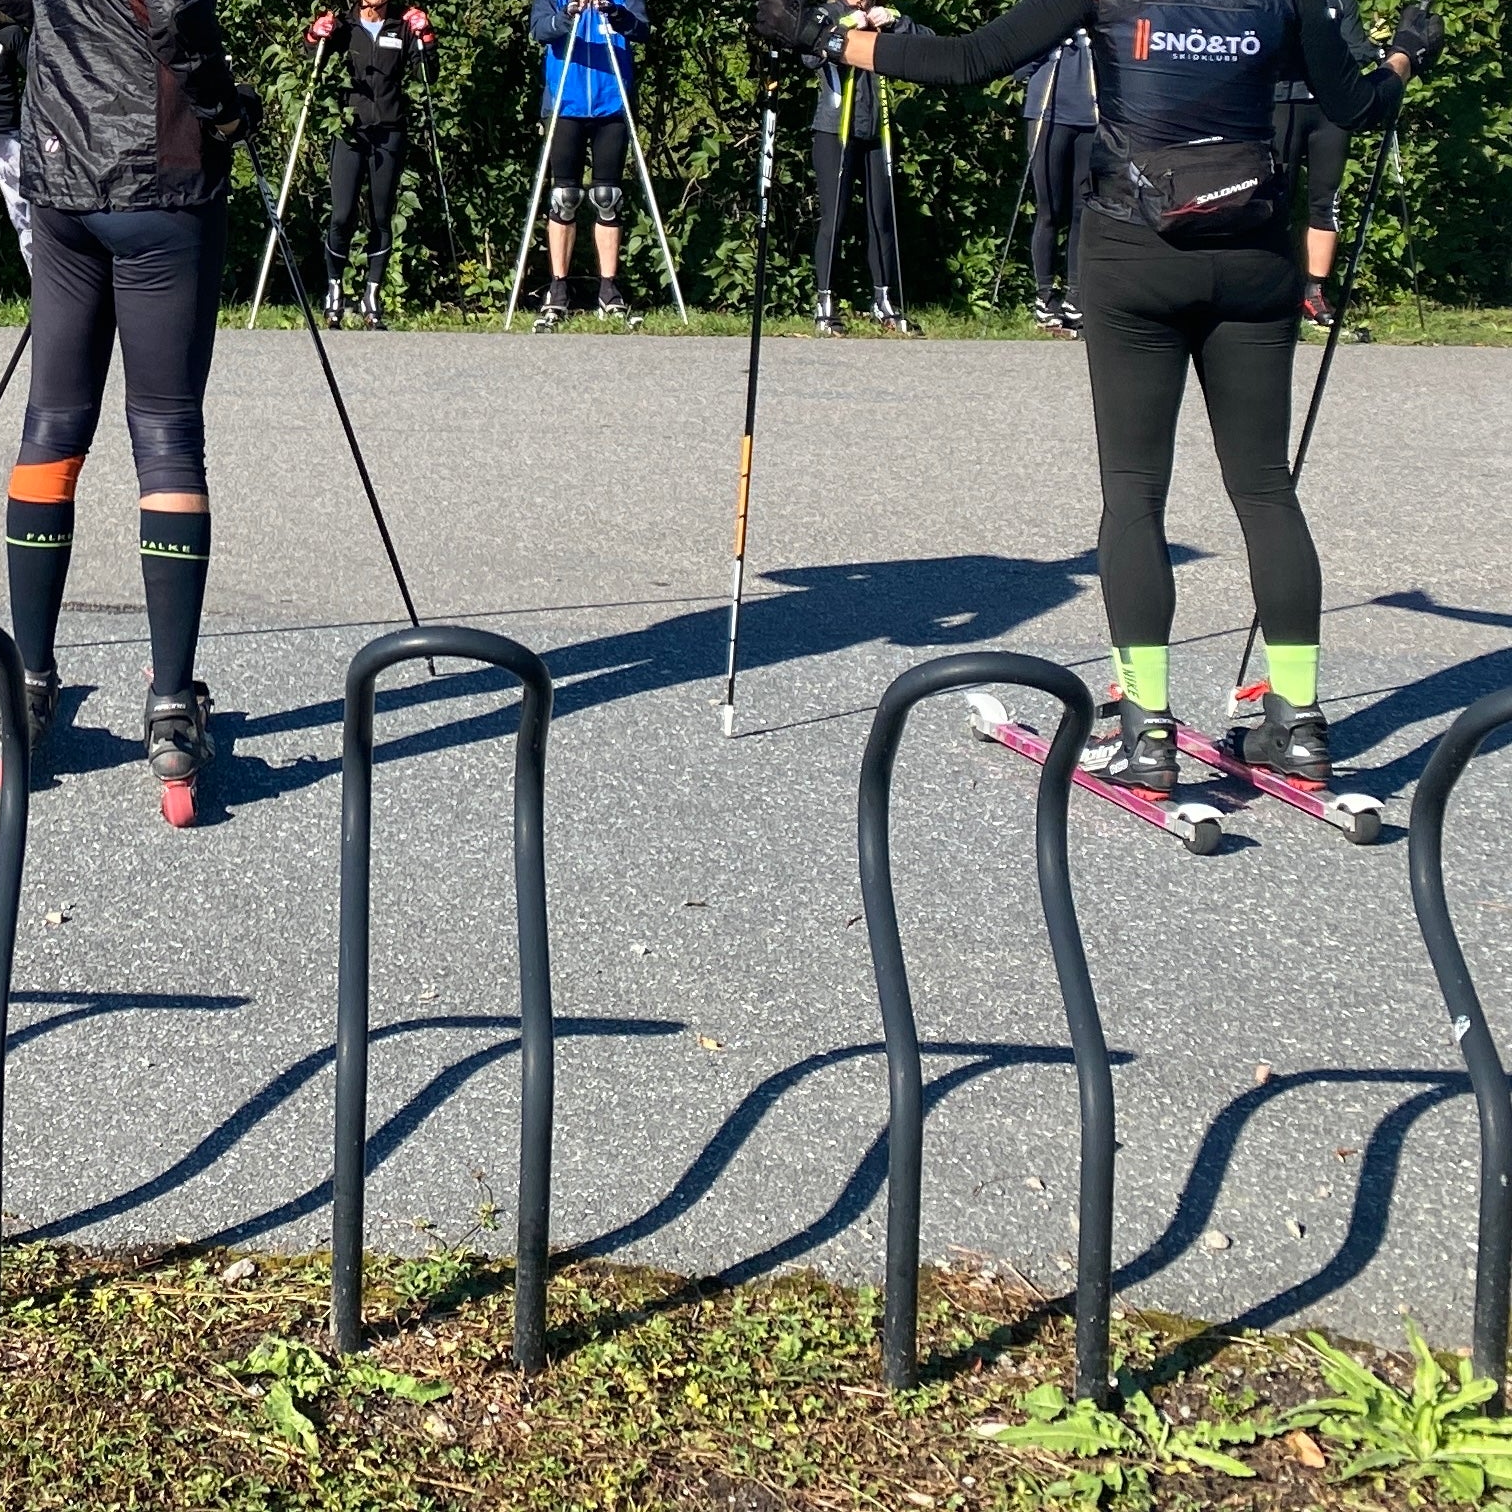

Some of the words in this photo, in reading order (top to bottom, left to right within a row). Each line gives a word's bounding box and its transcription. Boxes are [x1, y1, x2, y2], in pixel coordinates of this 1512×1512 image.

[1150, 28, 1261, 55] SNÖ&TÖ
[1196, 177, 1258, 205] SALOMON
[142, 540, 191, 553] FALKE
[1122, 667, 1141, 700] NIKE
